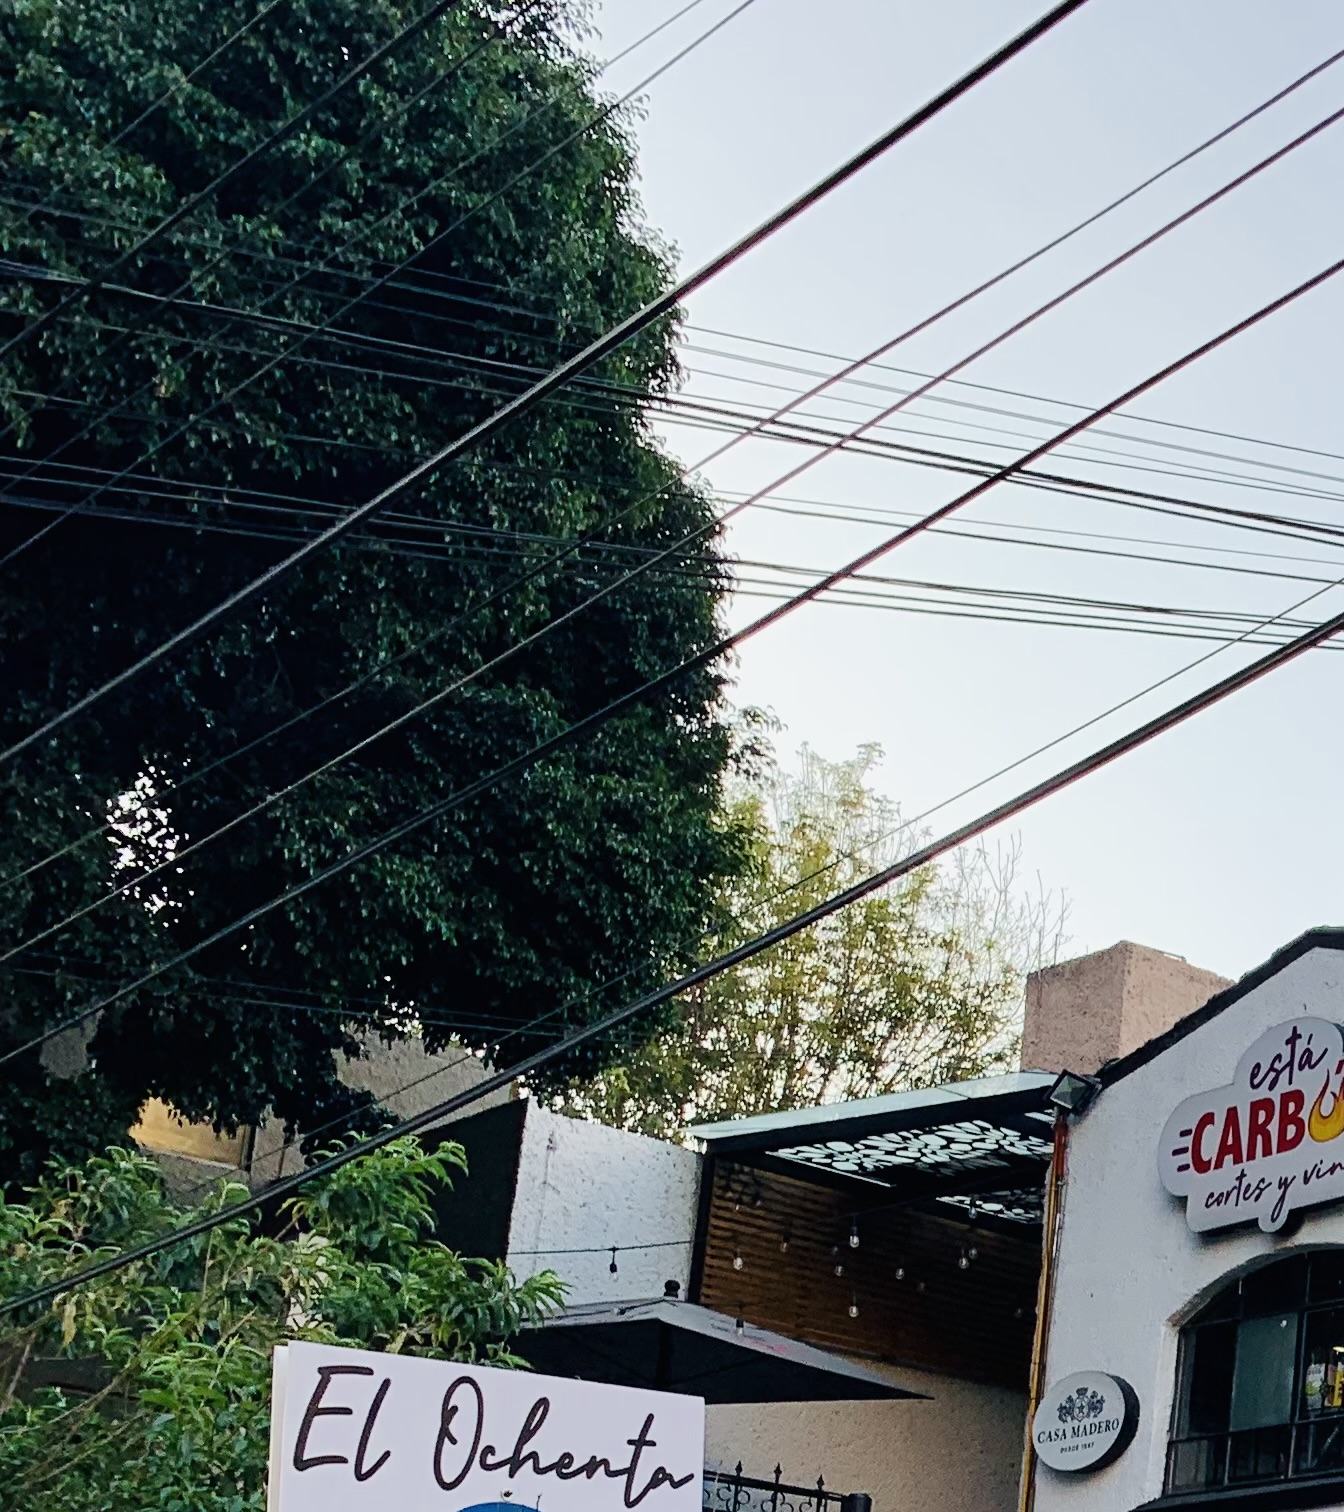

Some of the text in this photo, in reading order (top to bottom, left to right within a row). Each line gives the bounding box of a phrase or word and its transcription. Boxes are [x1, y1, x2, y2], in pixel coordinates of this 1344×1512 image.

[1249, 1025, 1329, 1092] está
[1204, 1168, 1272, 1209] cortes
[1270, 1174, 1297, 1224] y
[292, 1364, 695, 1510] El Ochenta
[1037, 1418, 1120, 1444] CASA MADERO
